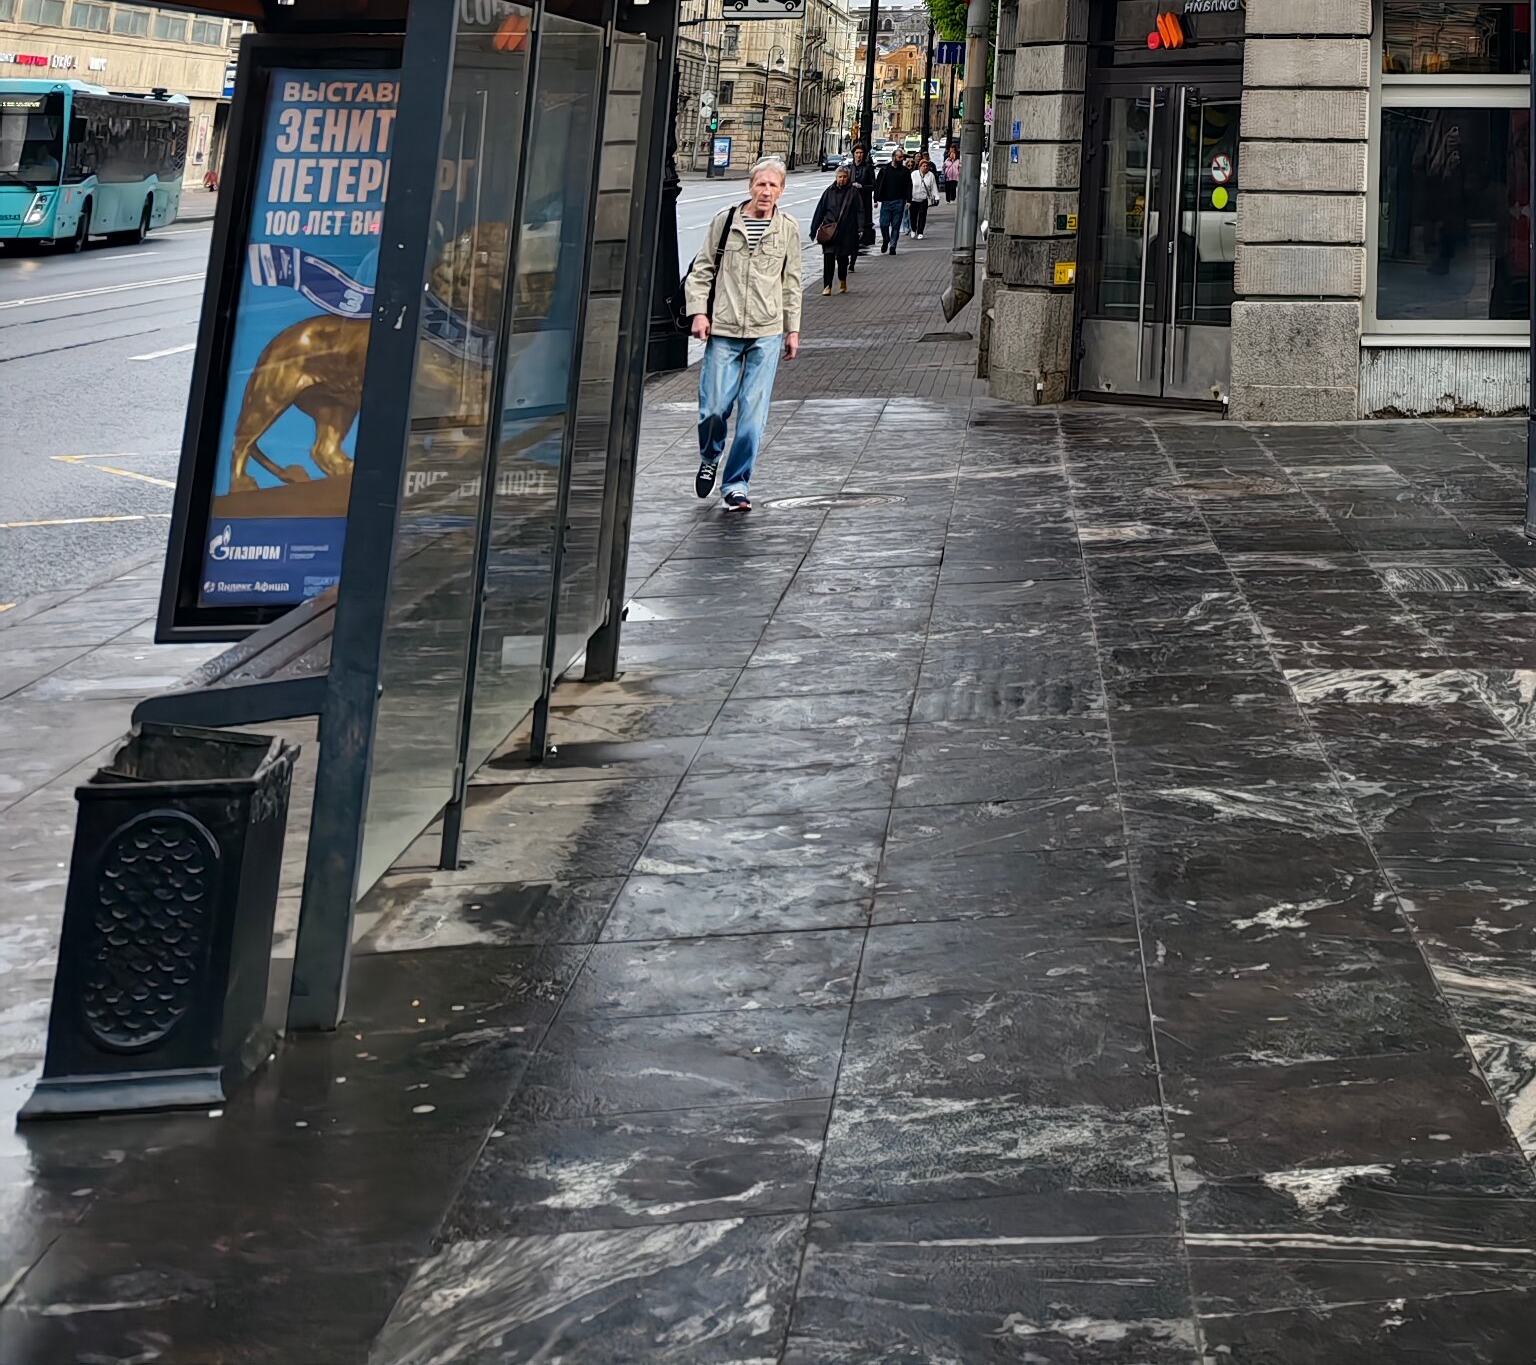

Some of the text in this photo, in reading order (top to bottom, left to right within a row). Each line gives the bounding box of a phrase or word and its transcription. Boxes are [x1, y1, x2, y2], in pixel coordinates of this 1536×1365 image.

[283, 81, 400, 103] ВЫСТАВ
[276, 108, 397, 153] ЗЕНИТ
[265, 210, 300, 236] 100
[304, 210, 346, 236] ЛЕТ
[228, 545, 281, 560] ГАЗПРОМ
[254, 580, 290, 592] Афиша
